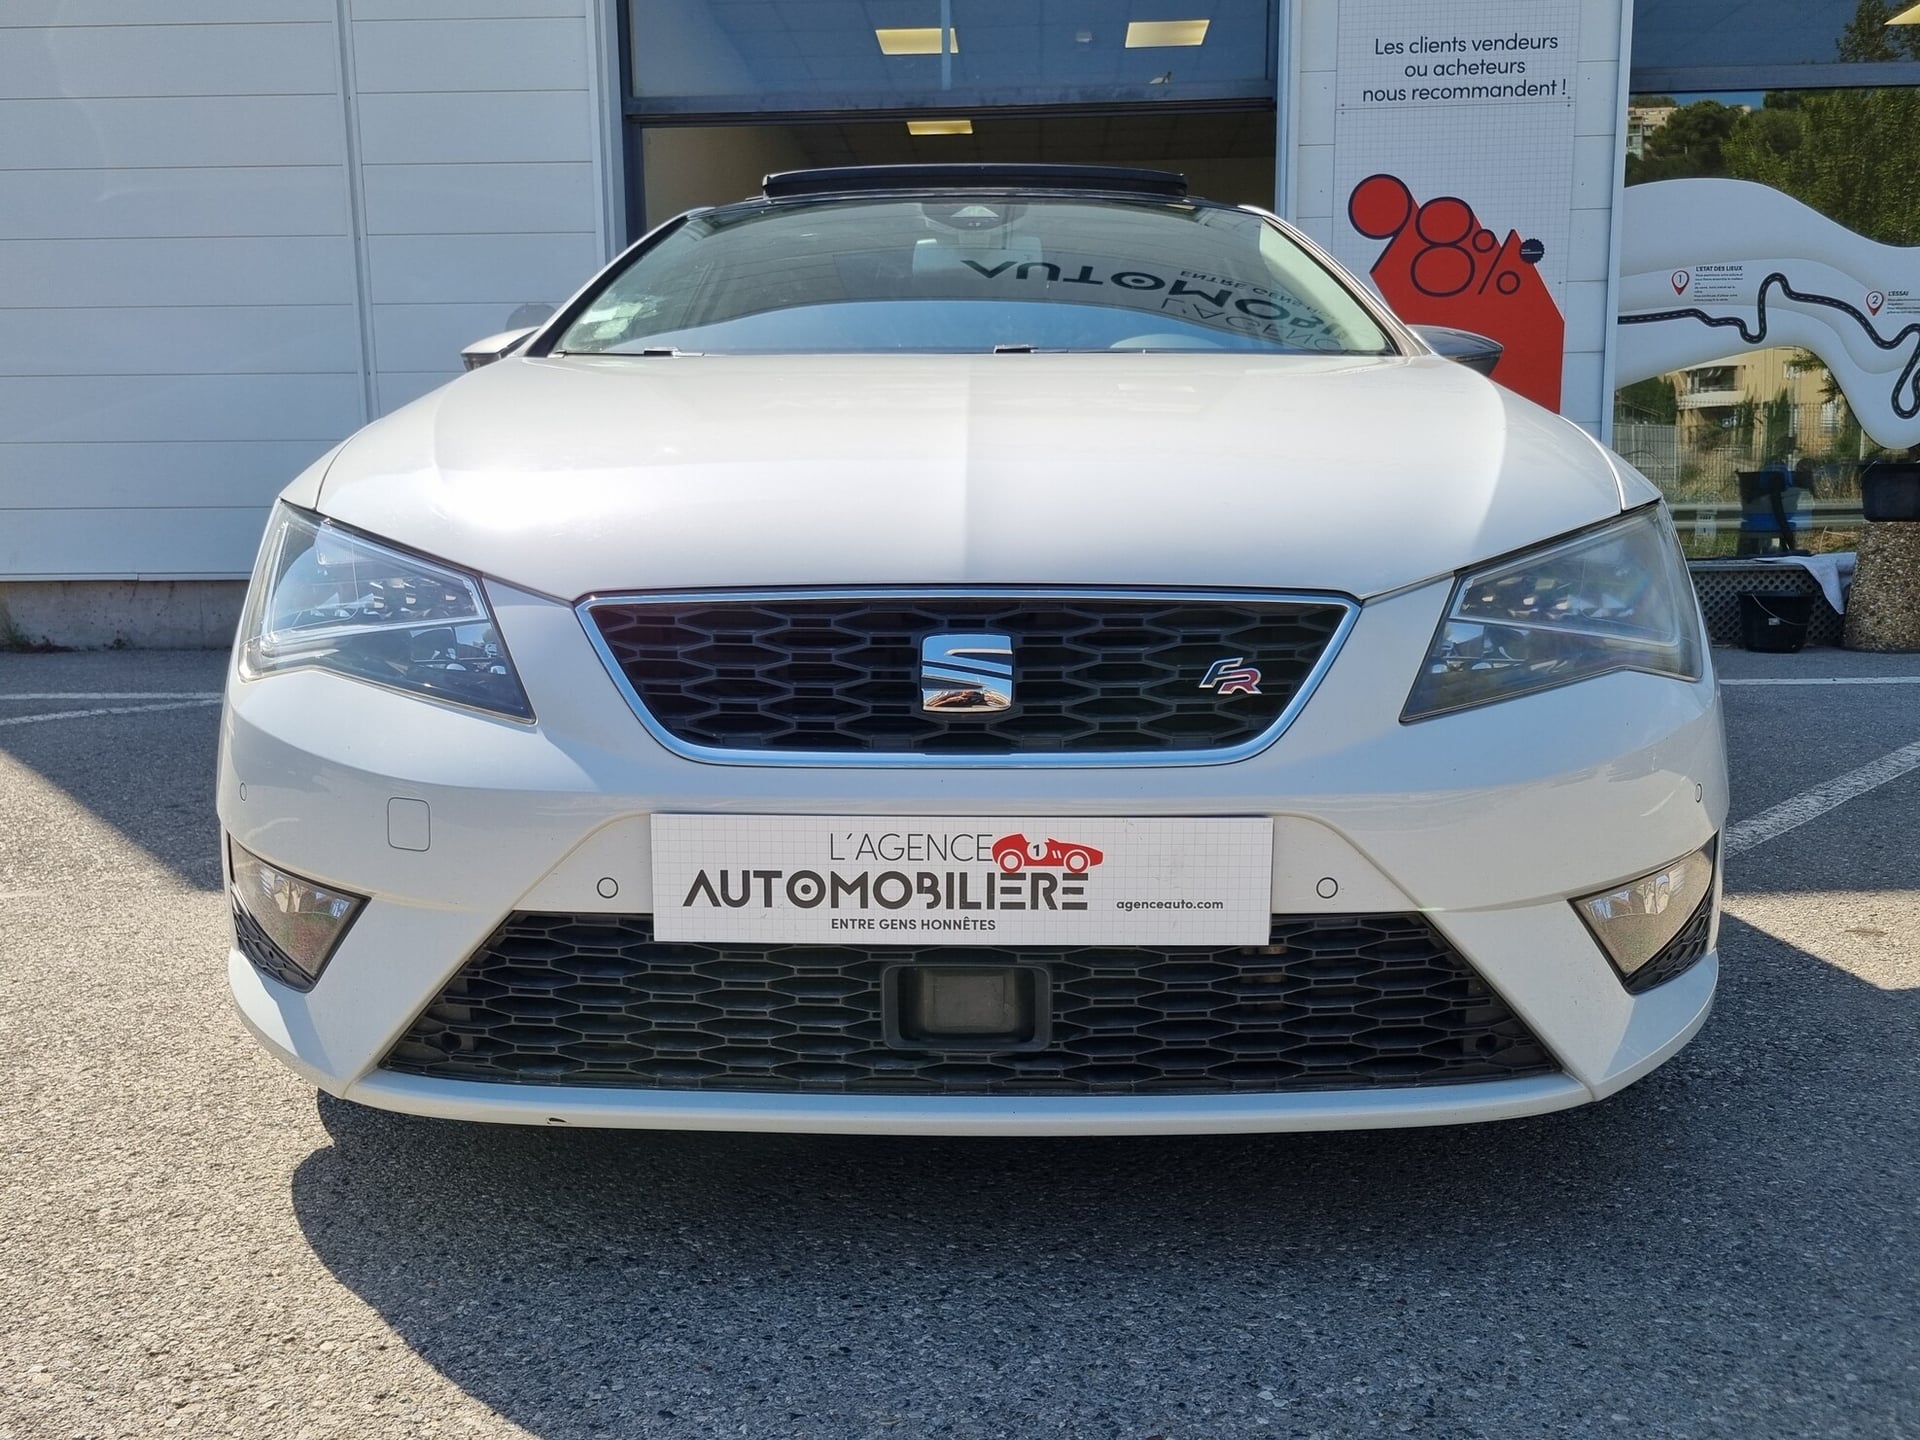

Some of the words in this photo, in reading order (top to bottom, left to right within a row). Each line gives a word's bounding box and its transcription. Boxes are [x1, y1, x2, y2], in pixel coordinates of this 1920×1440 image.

[1375, 38, 1404, 55] Les
[1409, 36, 1467, 54] clients
[1471, 33, 1559, 52] vendeurs
[1404, 65, 1428, 78] ou
[1433, 58, 1526, 77] acheteurs
[1362, 89, 1407, 102] nous
[1411, 79, 1557, 100] recommandent
[1872, 295, 1879, 305] 2
[1199, 657, 1262, 694] FR
[830, 832, 993, 862] L'AGENCE
[1032, 844, 1040, 857] 1
[1116, 899, 1224, 912] agenceauto.com
[831, 918, 875, 930] ENTRE
[879, 918, 917, 930] GENS
[921, 916, 996, 931] HONNÊTES
